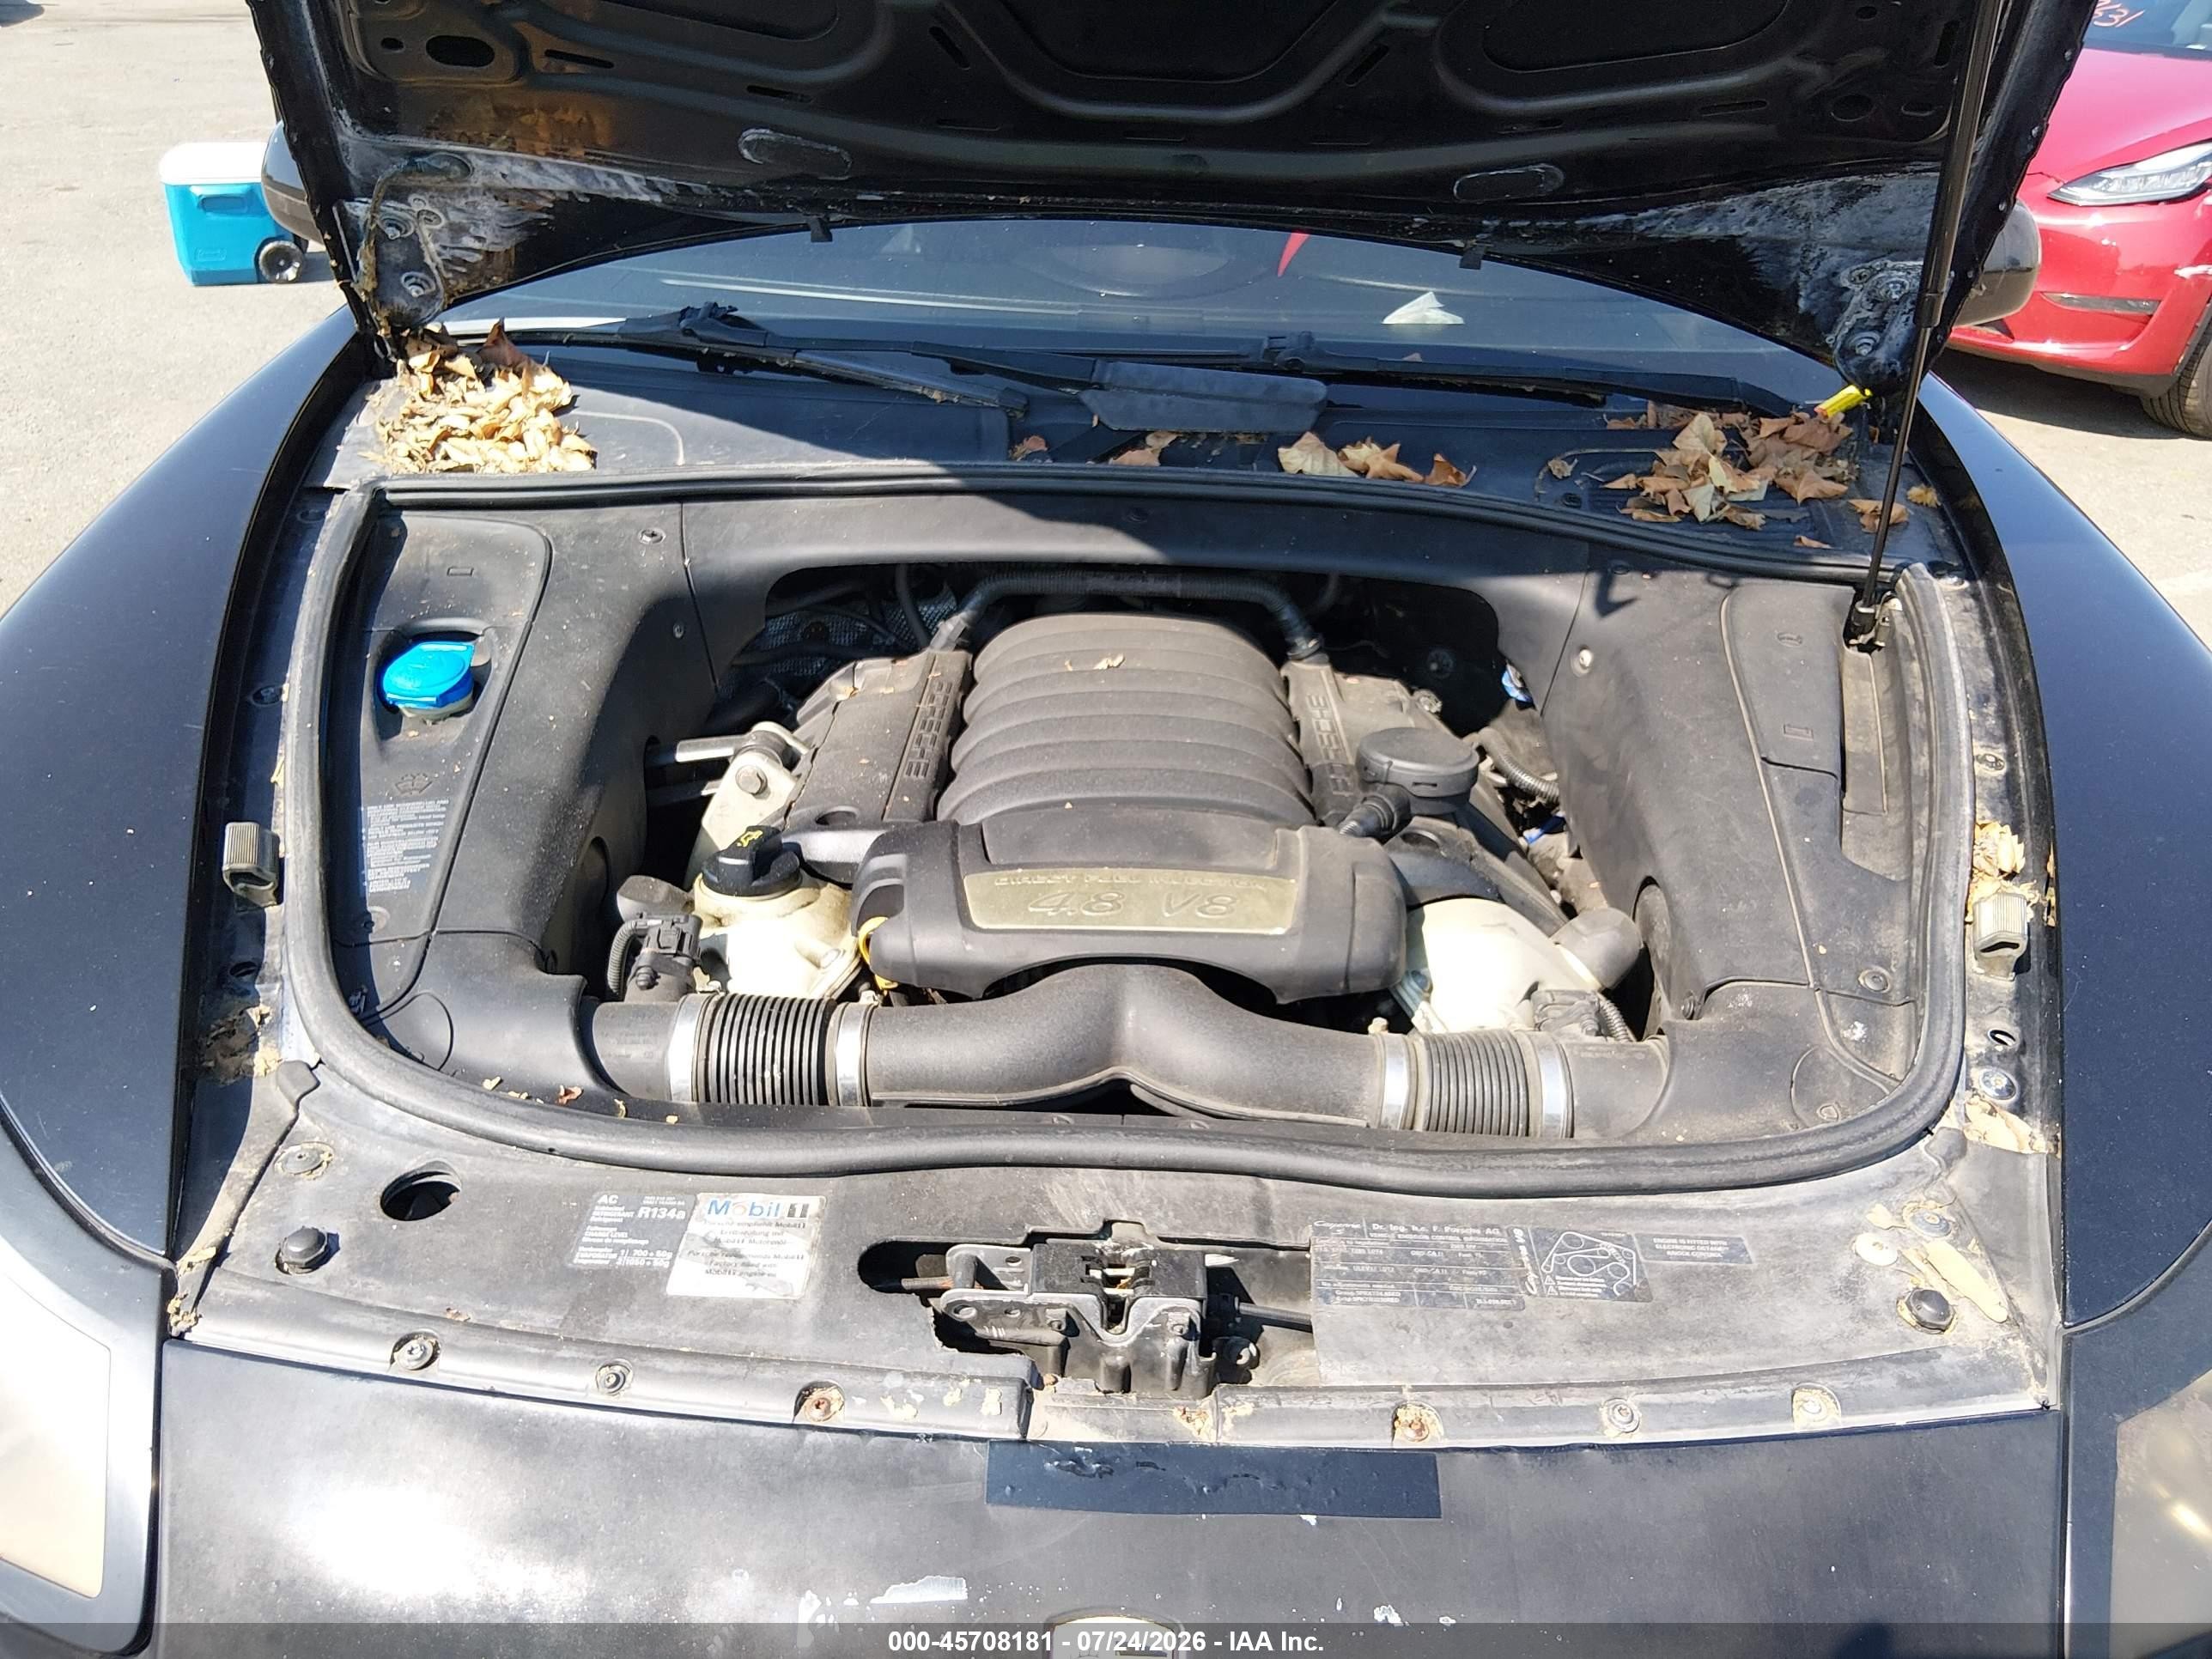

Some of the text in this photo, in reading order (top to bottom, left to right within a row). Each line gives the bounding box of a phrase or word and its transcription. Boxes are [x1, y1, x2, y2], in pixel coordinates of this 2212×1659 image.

[903, 681, 953, 778] PORSCHE
[1028, 890, 1238, 919] 4.8 V8
[597, 1194, 619, 1204] AC
[638, 1206, 686, 1219] R134a
[708, 1200, 781, 1218] Mobil
[1314, 1220, 1361, 1229] Cayenne
[1444, 1226, 1481, 1235] Porsche
